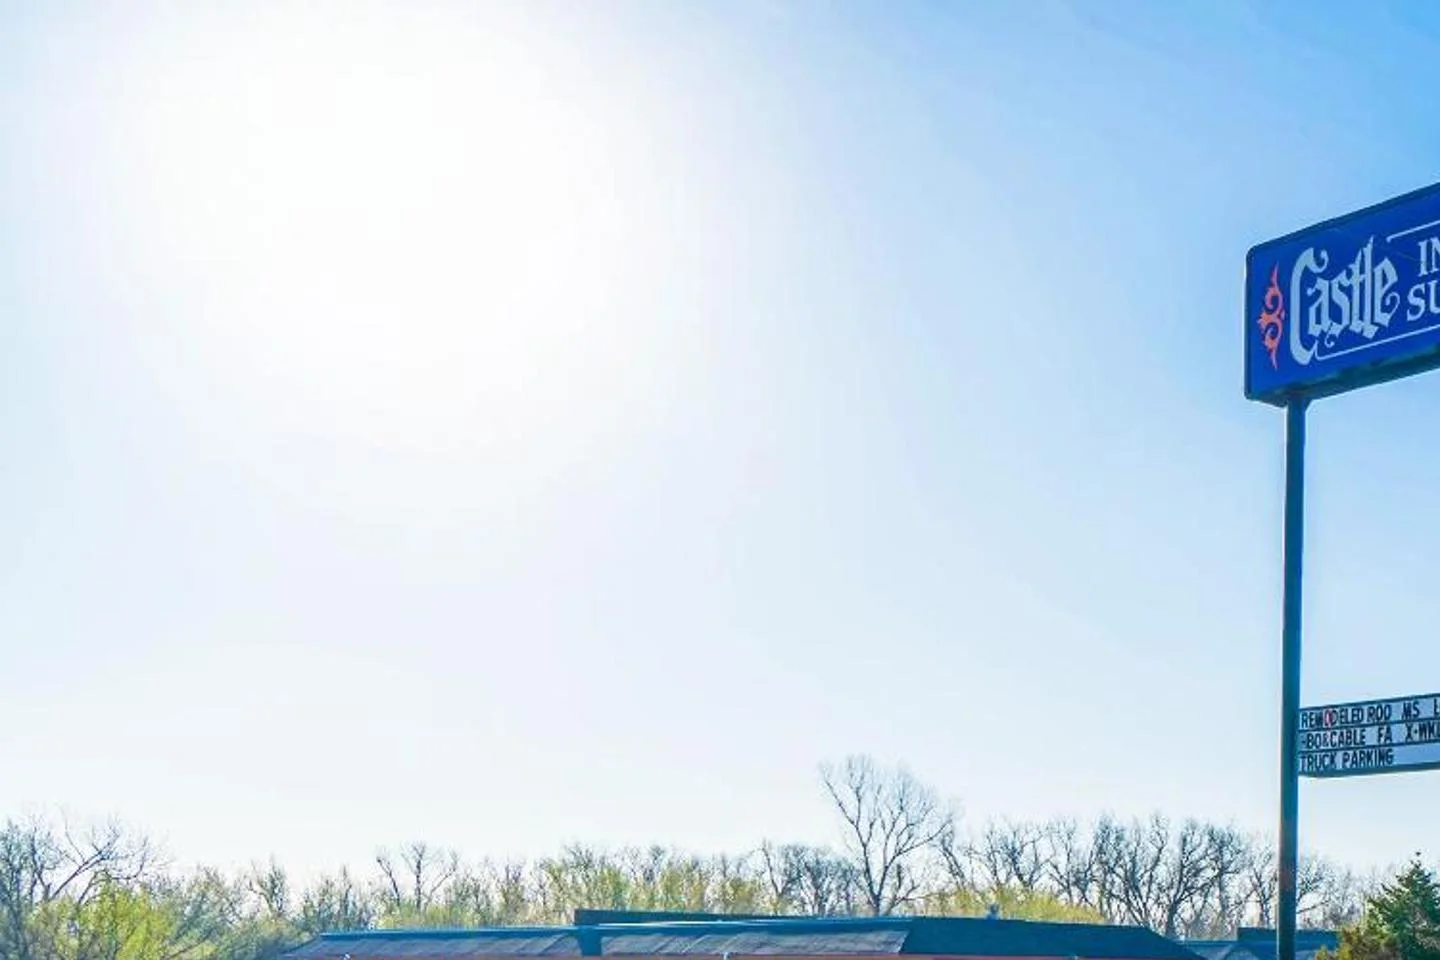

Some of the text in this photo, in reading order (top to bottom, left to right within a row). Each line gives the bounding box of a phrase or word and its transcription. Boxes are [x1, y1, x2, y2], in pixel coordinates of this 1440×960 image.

[1289, 235, 1400, 366] Castle
[1300, 751, 1338, 775] TRUCK
[1341, 747, 1394, 770] PARKING
